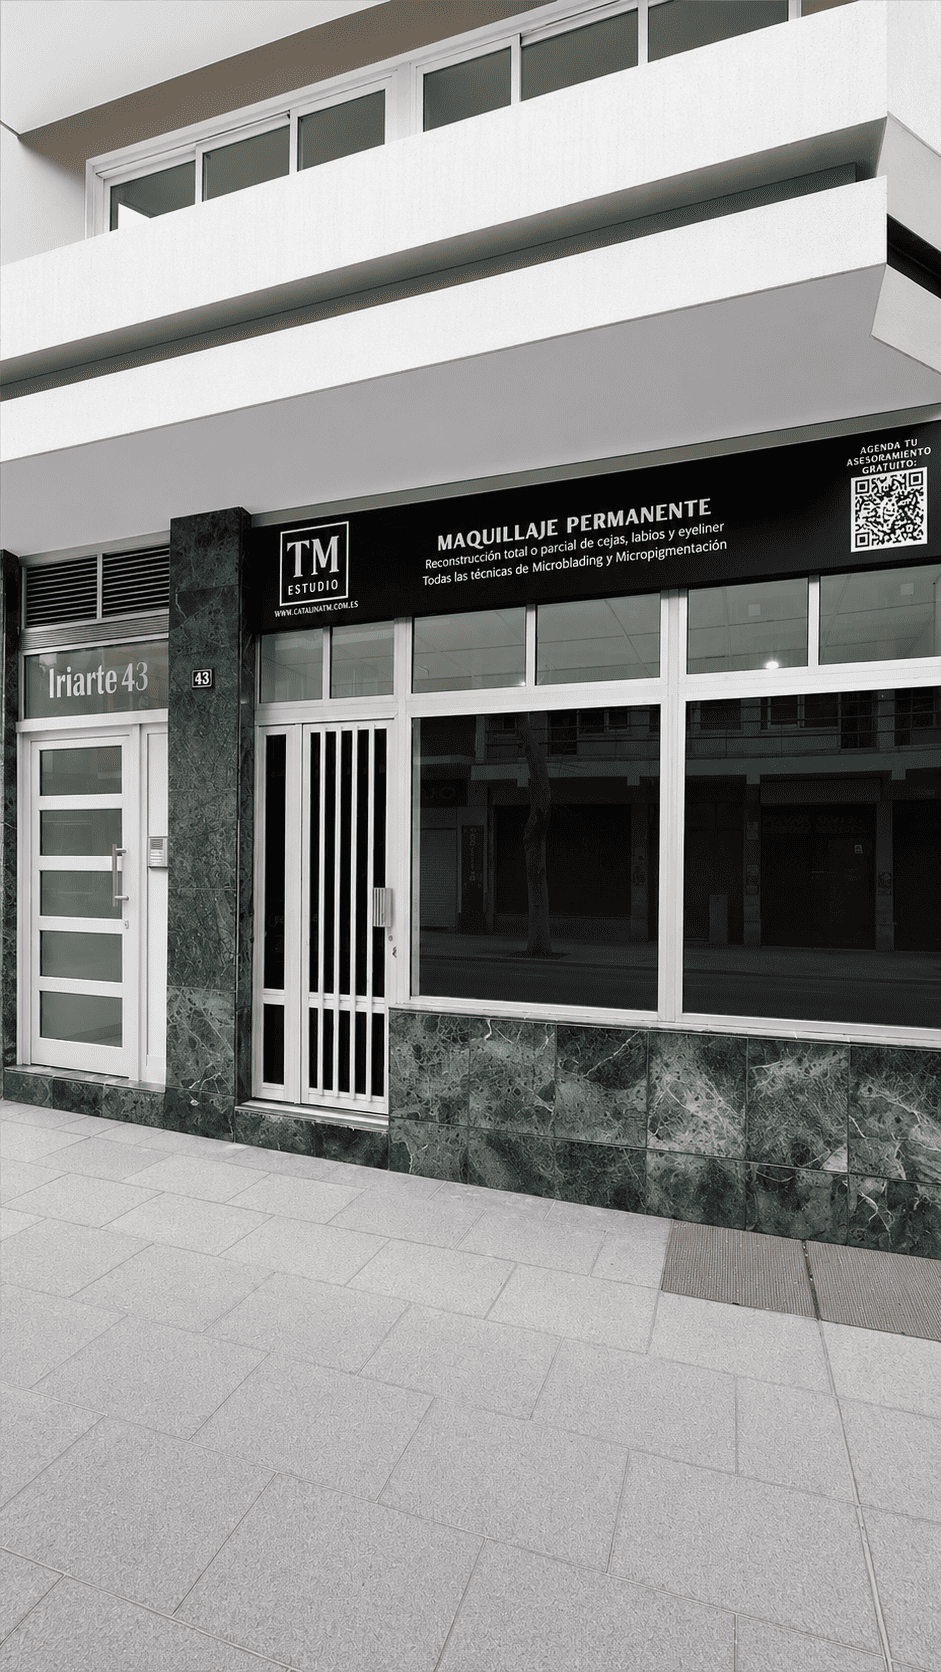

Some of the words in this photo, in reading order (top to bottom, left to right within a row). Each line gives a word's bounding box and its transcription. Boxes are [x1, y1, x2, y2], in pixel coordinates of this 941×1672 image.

[846, 446, 932, 466] ASESORAMIENTO
[860, 441, 900, 454] AGENDA
[904, 438, 918, 448] TU
[862, 459, 917, 474] GRATUITO:
[438, 519, 558, 551] MAQUILLAJE
[566, 498, 712, 534] PERMANENTE
[425, 550, 501, 570] Reconstrucción
[504, 546, 528, 559] total
[530, 547, 538, 556] o
[540, 539, 576, 557] parcial
[580, 538, 594, 550] de
[597, 534, 628, 549] cejas,
[631, 530, 666, 543] labios
[668, 530, 676, 541] y
[678, 522, 724, 539] eyeliner
[286, 535, 340, 578] TM
[422, 574, 452, 586] Todas
[454, 572, 468, 582] las
[470, 566, 512, 580] técnicas
[515, 564, 529, 575] de
[532, 556, 604, 572] Microblading
[606, 554, 614, 566] y
[616, 539, 728, 562] Micropigmentación
[288, 579, 338, 596] ESTUDIO
[274, 600, 359, 618] WWW.CATALINATM.COM.ES
[50, 664, 118, 698] Iriarte
[122, 662, 148, 692] 43
[194, 672, 210, 685] 43
